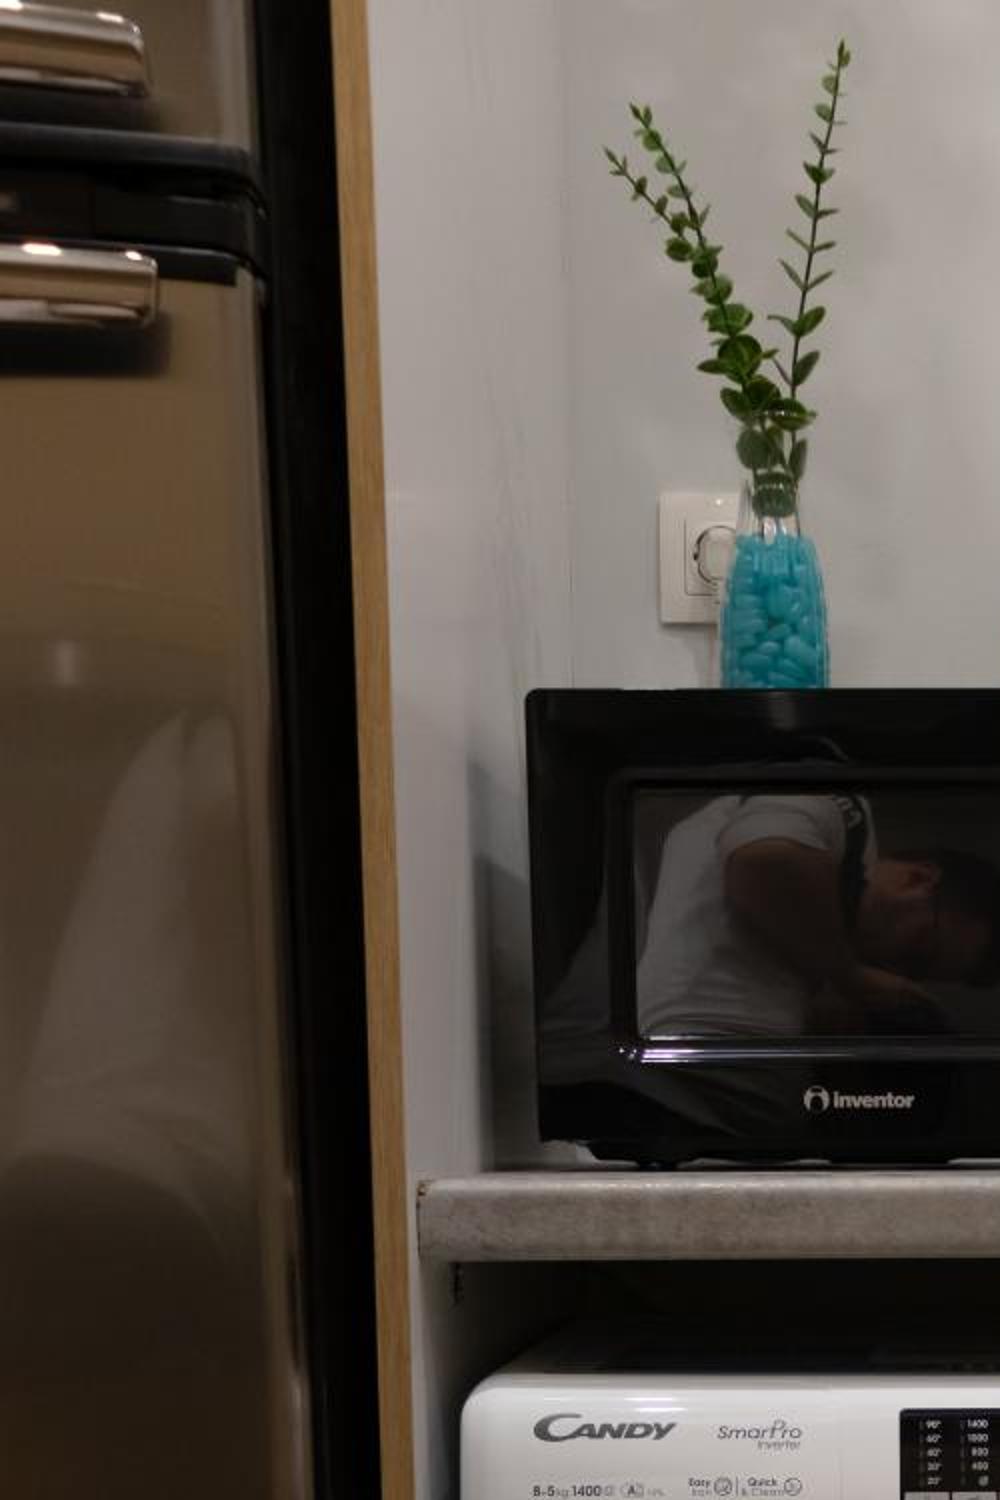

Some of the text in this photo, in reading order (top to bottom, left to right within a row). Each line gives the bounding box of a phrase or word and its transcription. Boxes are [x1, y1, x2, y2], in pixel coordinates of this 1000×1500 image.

[833, 1091, 915, 1109] inventor
[533, 1413, 677, 1442] CANDY
[572, 1485, 602, 1497] 1400
